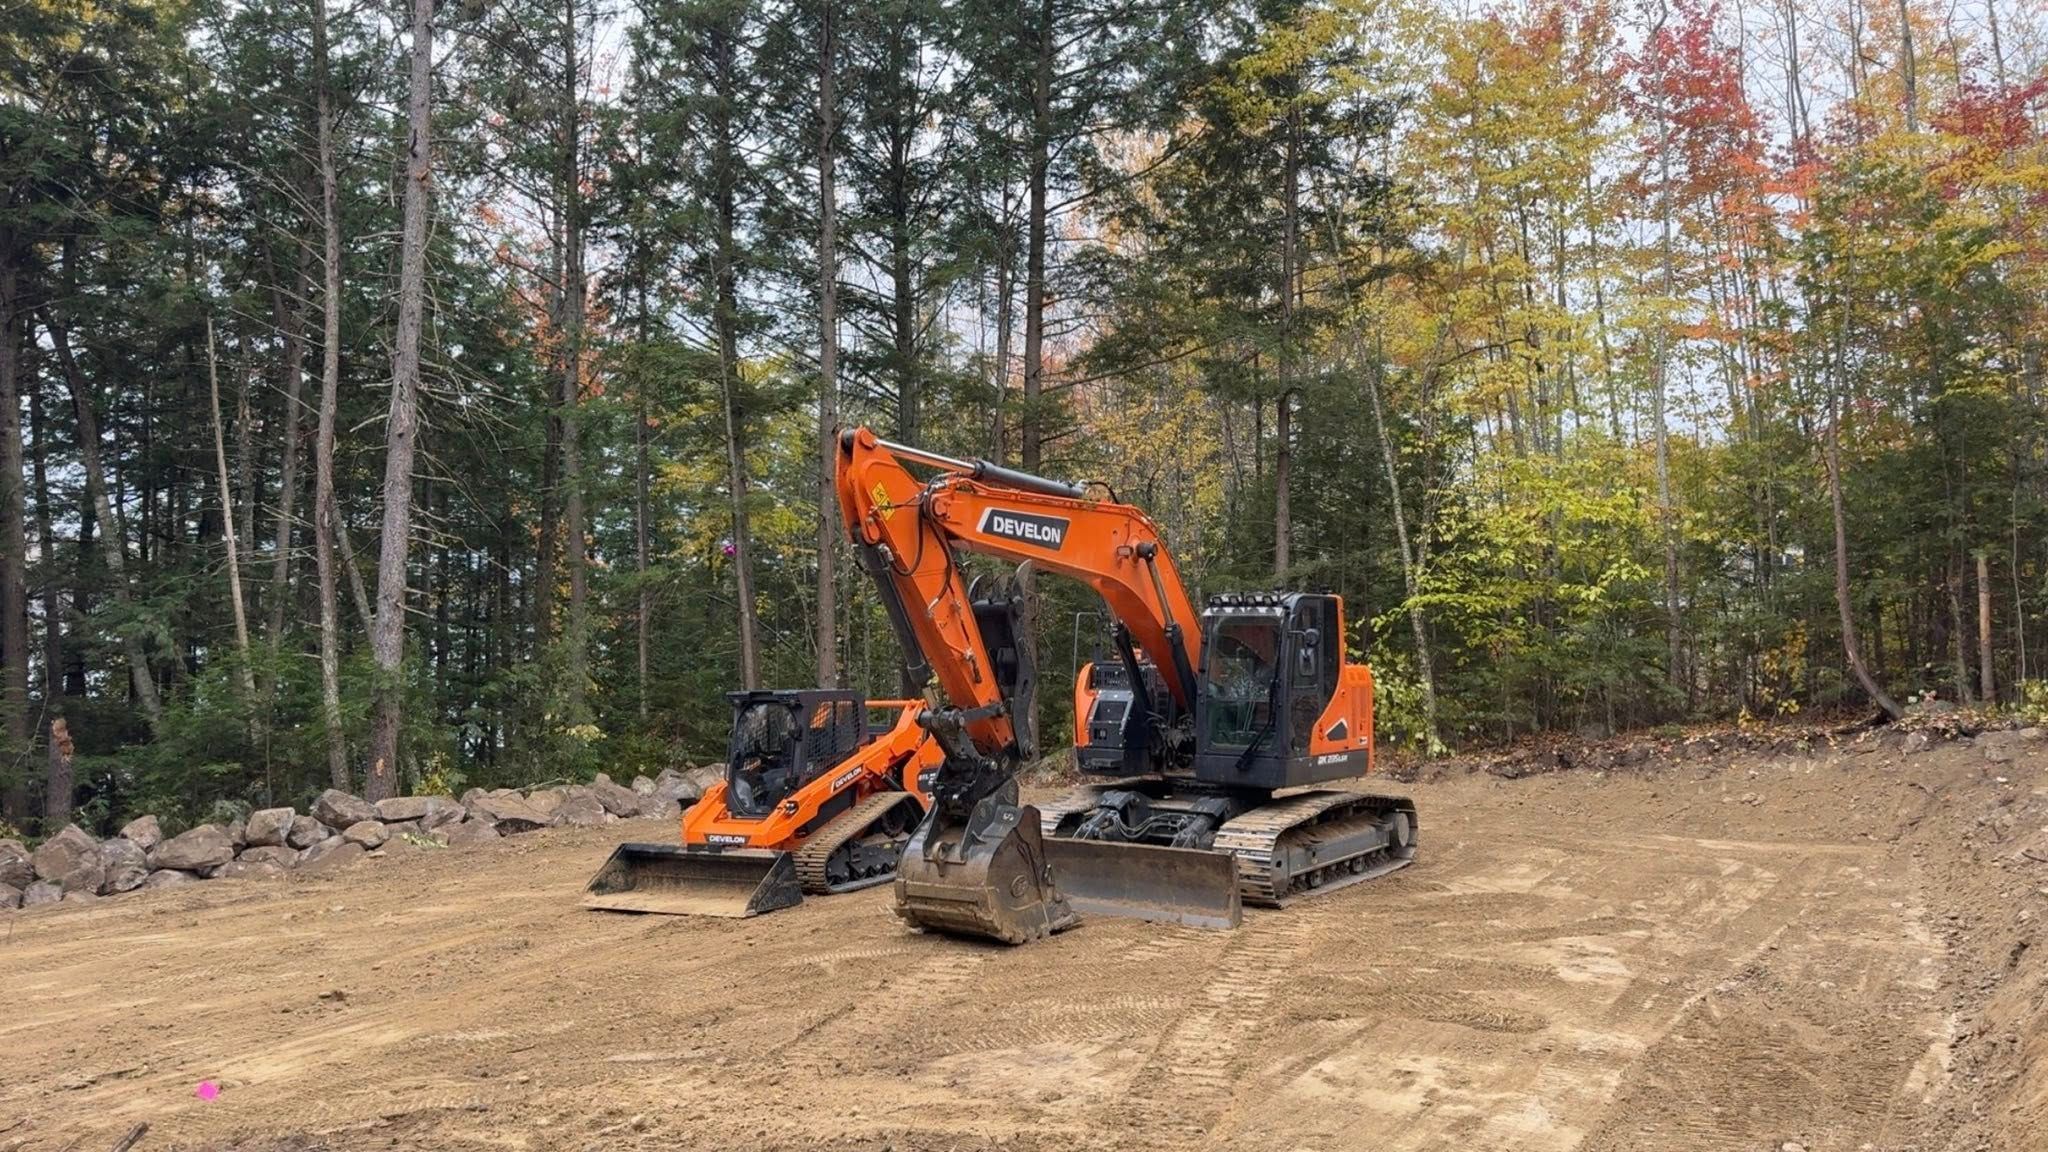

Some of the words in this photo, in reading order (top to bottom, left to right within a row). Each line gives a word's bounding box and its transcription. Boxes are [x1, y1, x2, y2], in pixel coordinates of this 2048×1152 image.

[993, 516, 1061, 543] DEVELON
[835, 766, 862, 788] DEVELON
[709, 834, 746, 844] DEVELON
